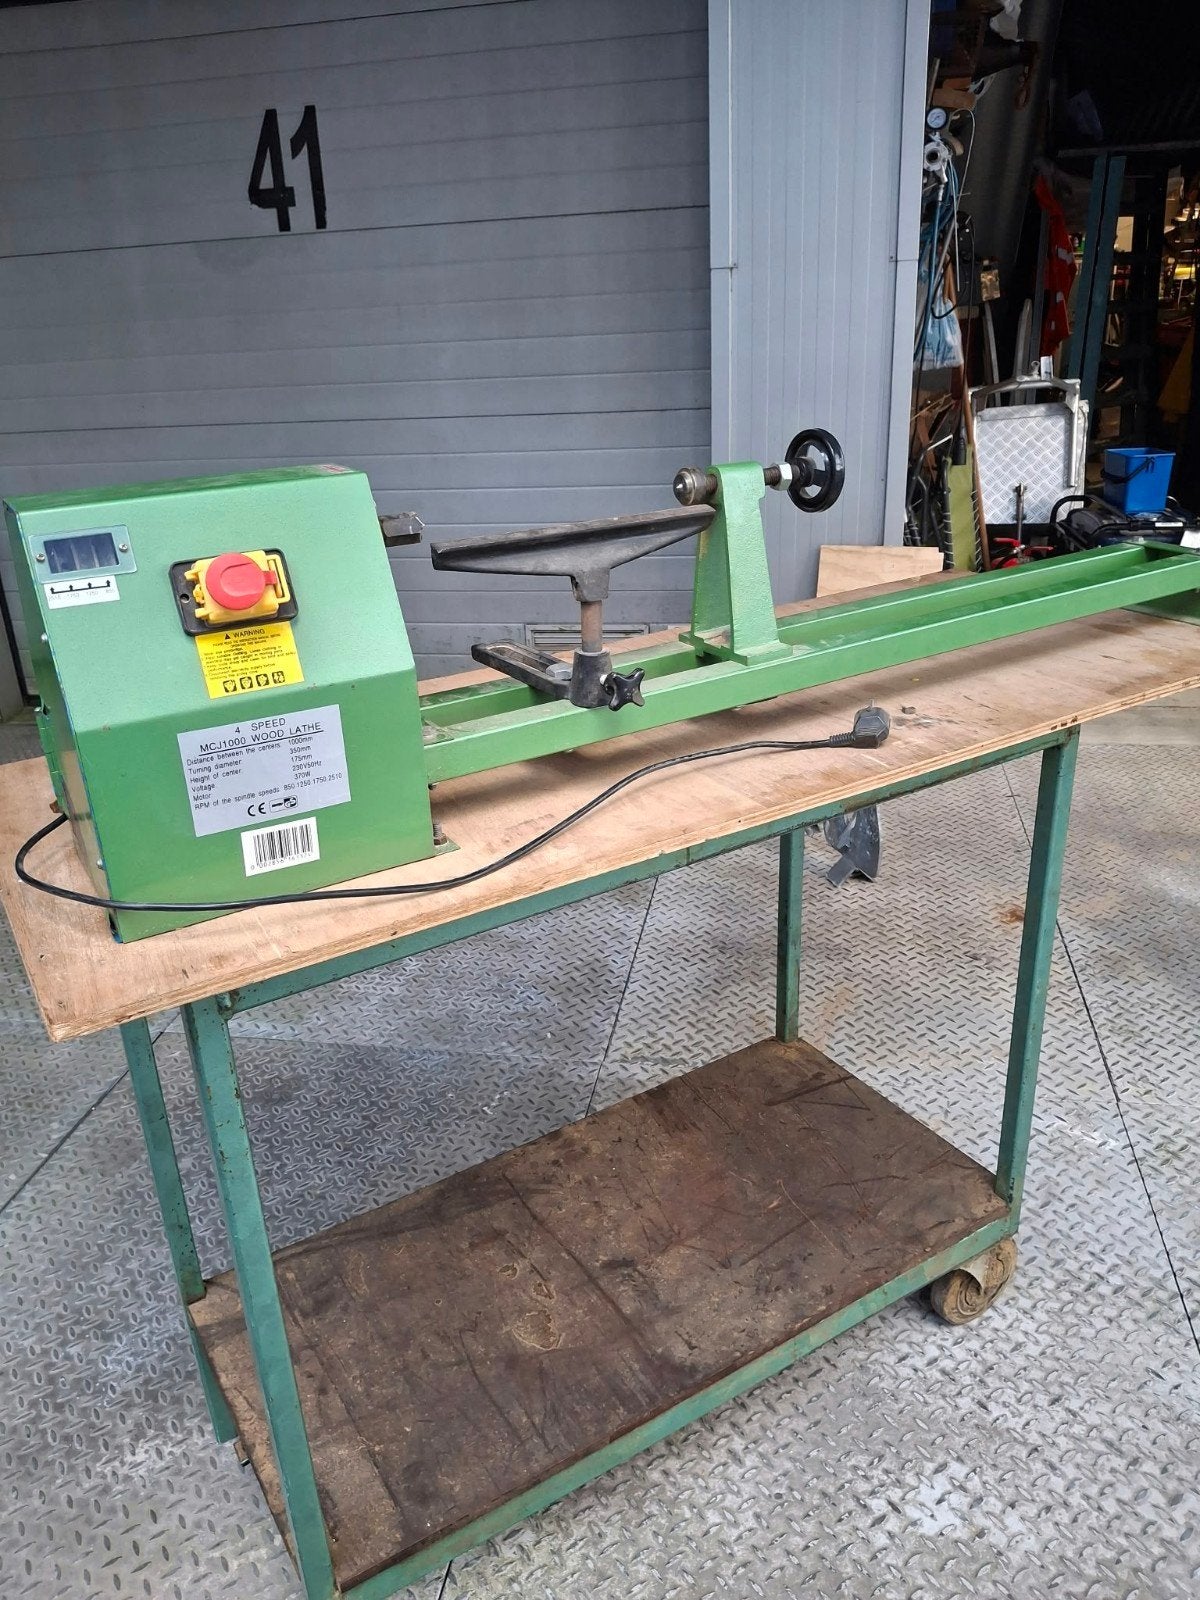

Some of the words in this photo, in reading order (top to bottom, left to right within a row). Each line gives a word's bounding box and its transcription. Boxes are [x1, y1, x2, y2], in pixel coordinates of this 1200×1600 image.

[248, 105, 327, 232] 41
[233, 628, 266, 639] WARNING
[199, 737, 247, 753] MCJ1000
[251, 729, 285, 743] WOOD
[289, 722, 322, 735] LATHE
[251, 718, 286, 732] SPEED
[186, 755, 215, 767] Distance
[217, 749, 244, 761] between
[246, 747, 256, 755] the
[258, 743, 281, 752] centers
[288, 735, 314, 746] 1000mm
[188, 765, 212, 776] Turning
[214, 759, 242, 770] diameter
[289, 745, 312, 755] 350mm
[190, 775, 211, 786] Height
[221, 768, 242, 778] center
[291, 753, 313, 763] 175mm
[191, 783, 216, 795] Voltage
[193, 793, 212, 802] Motor
[294, 771, 312, 780] 370W
[194, 802, 210, 811] RPM
[221, 797, 232, 805] the
[234, 792, 256, 803] spindle
[258, 786, 280, 797] speeds
[283, 783, 295, 791] 850
[296, 779, 311, 788] 1250
[312, 776, 327, 784] 1750
[328, 772, 343, 781] 2510
